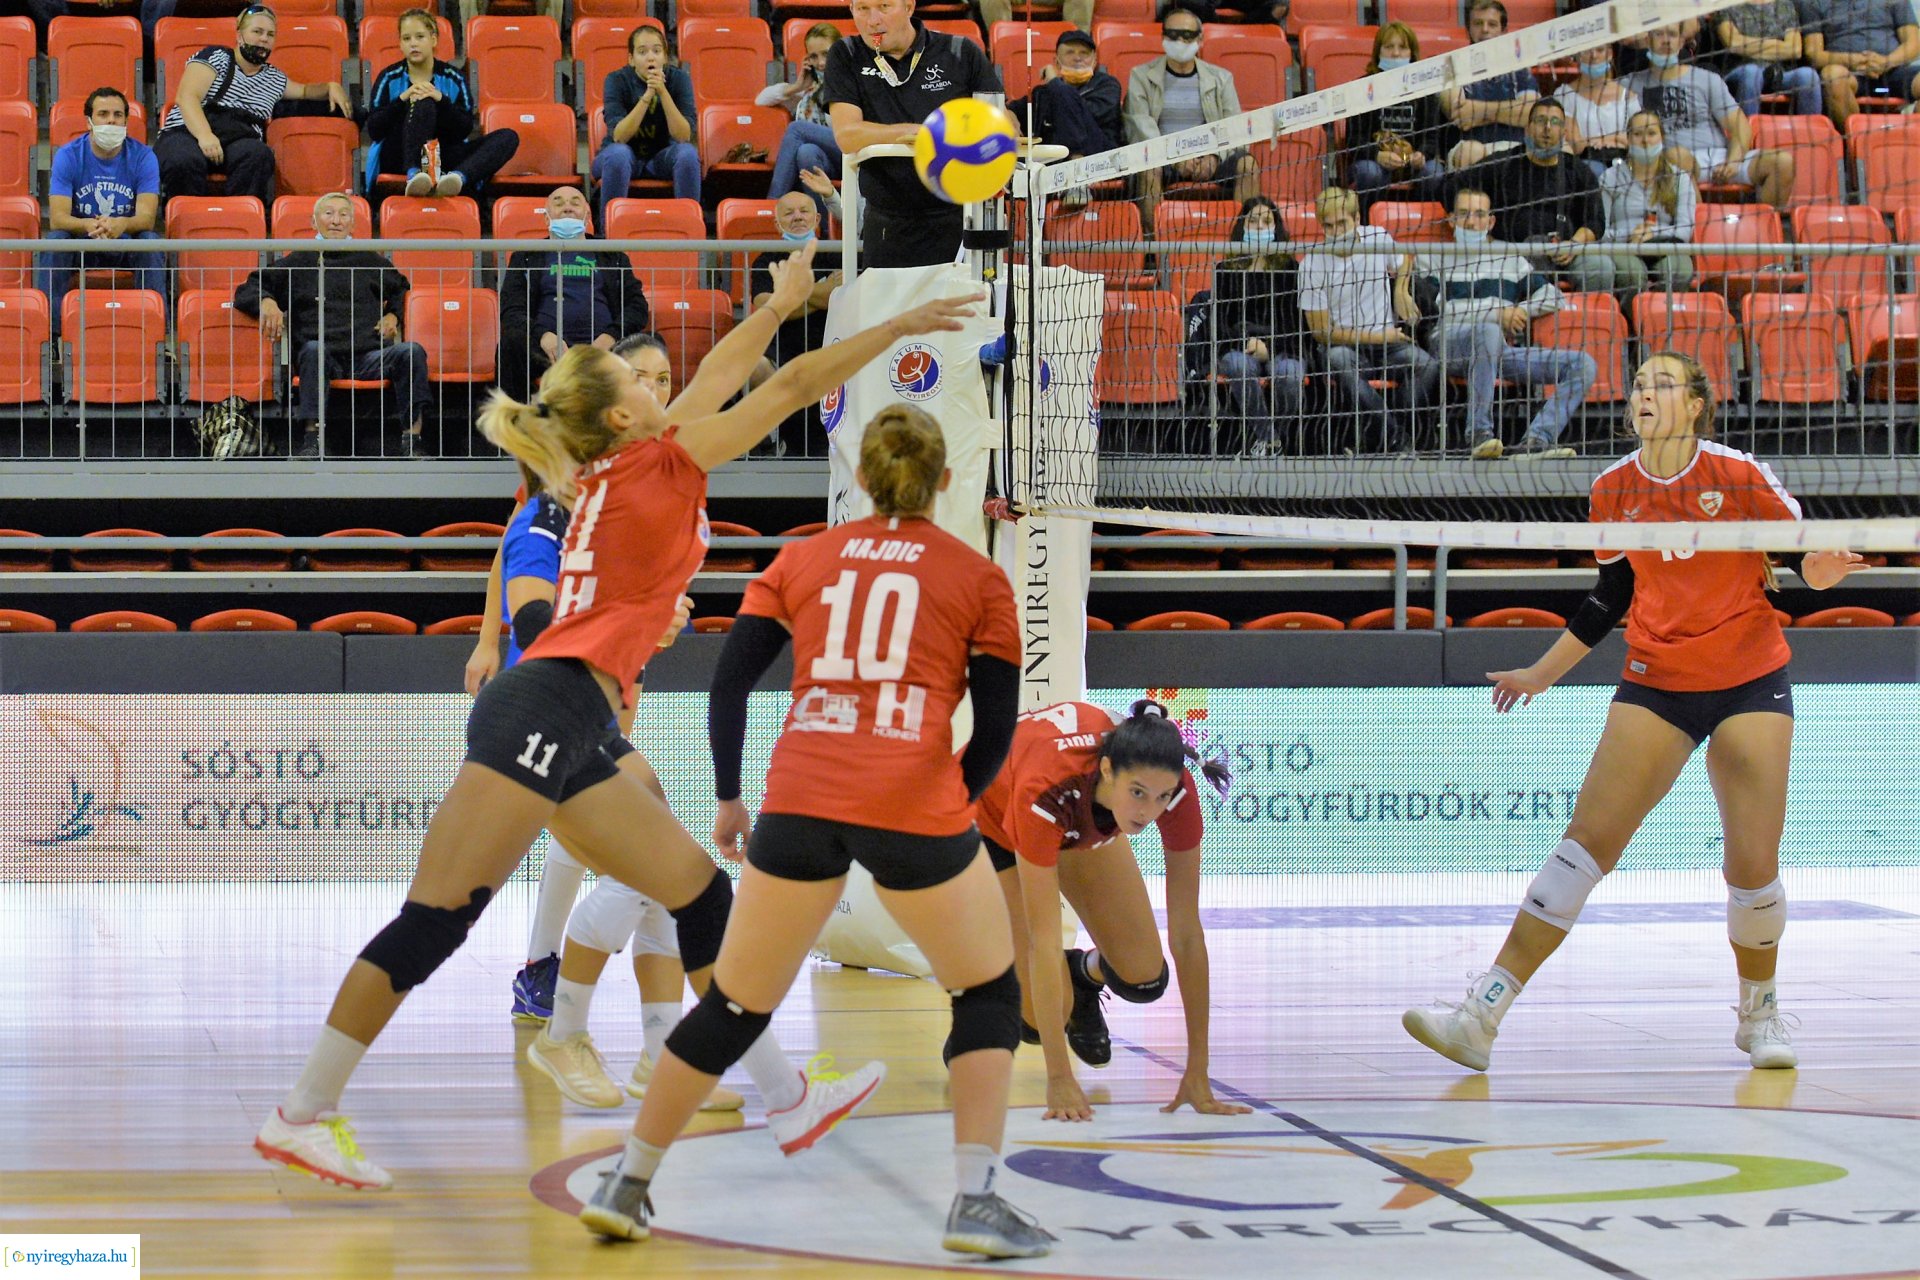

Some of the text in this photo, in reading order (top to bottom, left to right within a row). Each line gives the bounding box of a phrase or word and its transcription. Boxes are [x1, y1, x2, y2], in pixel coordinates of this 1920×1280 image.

[840, 538, 926, 563] NAJDIC
[811, 569, 920, 681] 10
[516, 732, 559, 778] 11
[1053, 734, 1097, 752] RUIZ
[1190, 733, 1315, 774] ÓSTÓ
[1039, 1198, 1920, 1242] YÍREGYHÁZ
